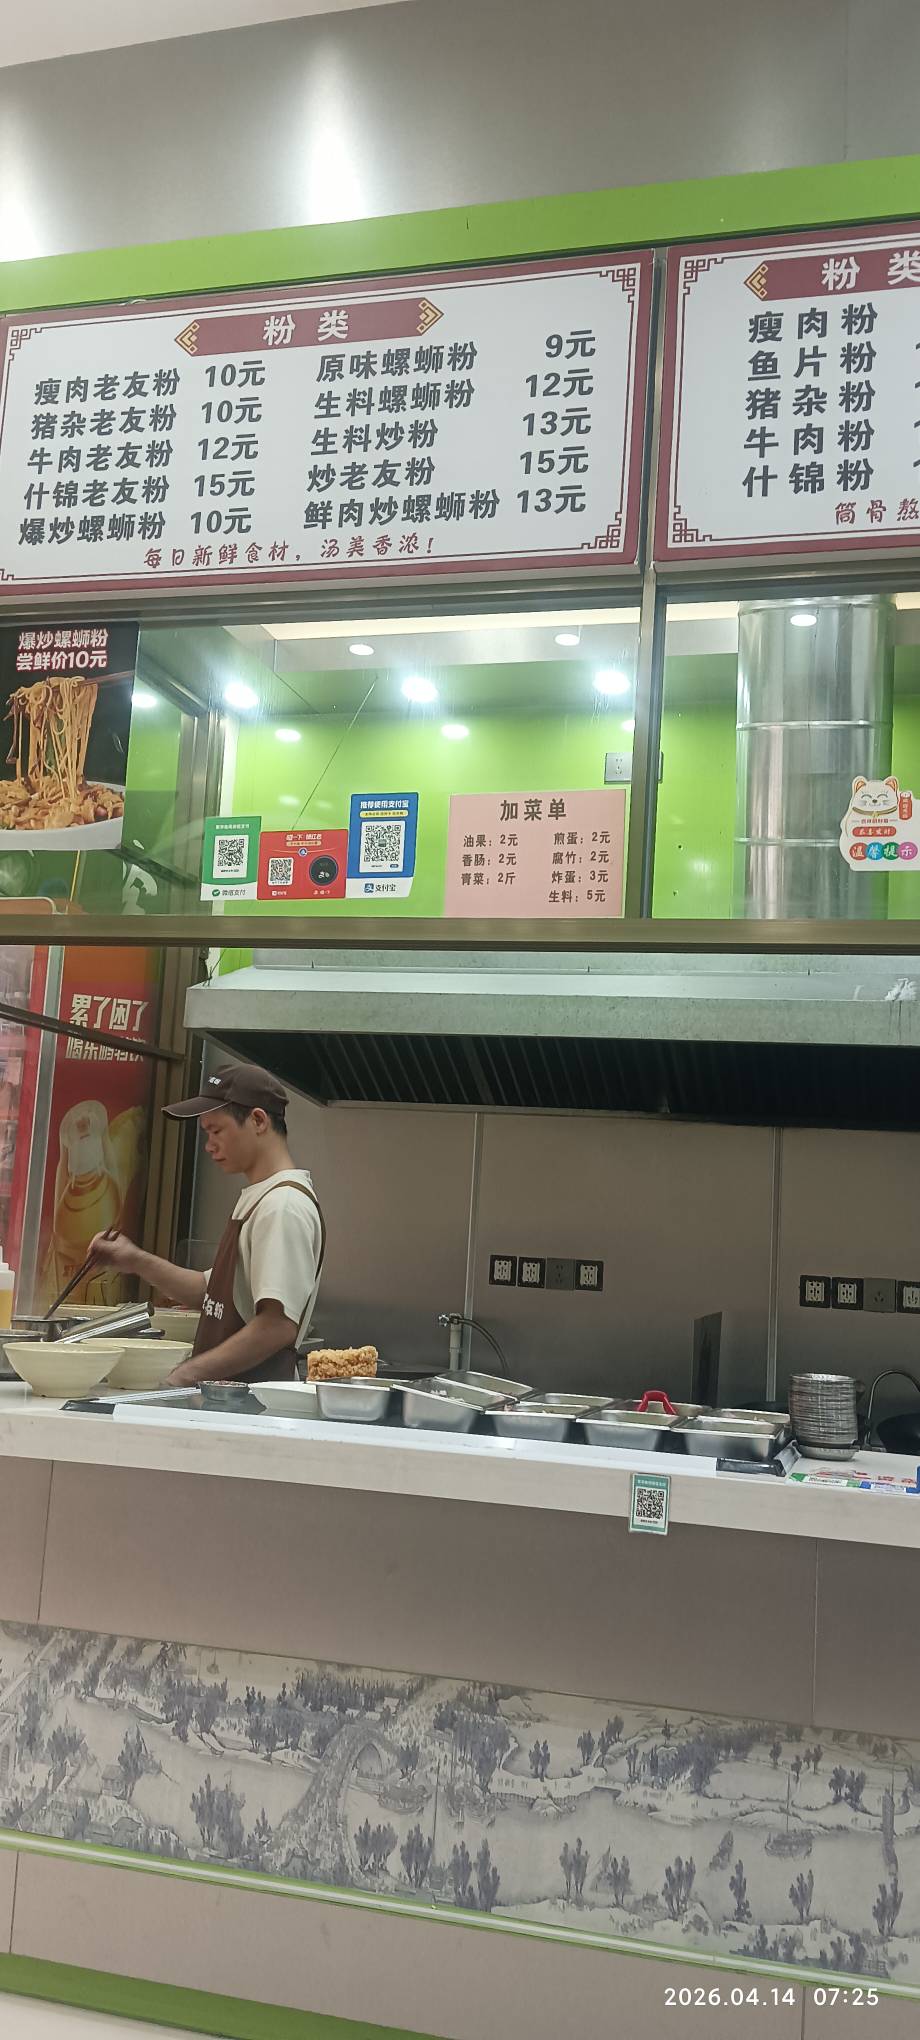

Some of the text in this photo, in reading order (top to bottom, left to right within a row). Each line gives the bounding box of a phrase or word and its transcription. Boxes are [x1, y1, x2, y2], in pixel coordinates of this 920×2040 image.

[263, 310, 351, 345] 粉类
[748, 302, 878, 344] 瘦肉粉
[316, 329, 597, 383] 原味螺蛳粉 9元
[747, 341, 876, 382] 鱼片粉
[34, 360, 266, 406] 瘦肉老友粉 10元
[314, 368, 594, 420] 生料螺蛳粉 12元
[745, 380, 875, 420] 猪杂粉
[31, 396, 263, 440] 猪杂老友粉 10元
[311, 406, 592, 457] 生料炒粉 13元
[743, 418, 875, 459] 牛肉粉
[27, 432, 259, 475] 牛肉老友粉 12元
[307, 446, 589, 492] 炒老友粉 15元
[23, 469, 256, 510] 什锦老友粉 15元
[742, 458, 874, 498] 什锦粉
[18, 506, 252, 546] 爆炒螺蛳粉 10元
[303, 483, 587, 530] 鲜肉炒螺蛳粉 13元
[18, 628, 109, 650] 爆炒螺蛳粉
[16, 650, 108, 671] 尝鲜价10元
[360, 799, 409, 809] 推荐使用支付宝
[500, 798, 567, 821] 加菜单
[375, 883, 396, 892] 支付宝
[70, 993, 150, 1032] 累了困了
